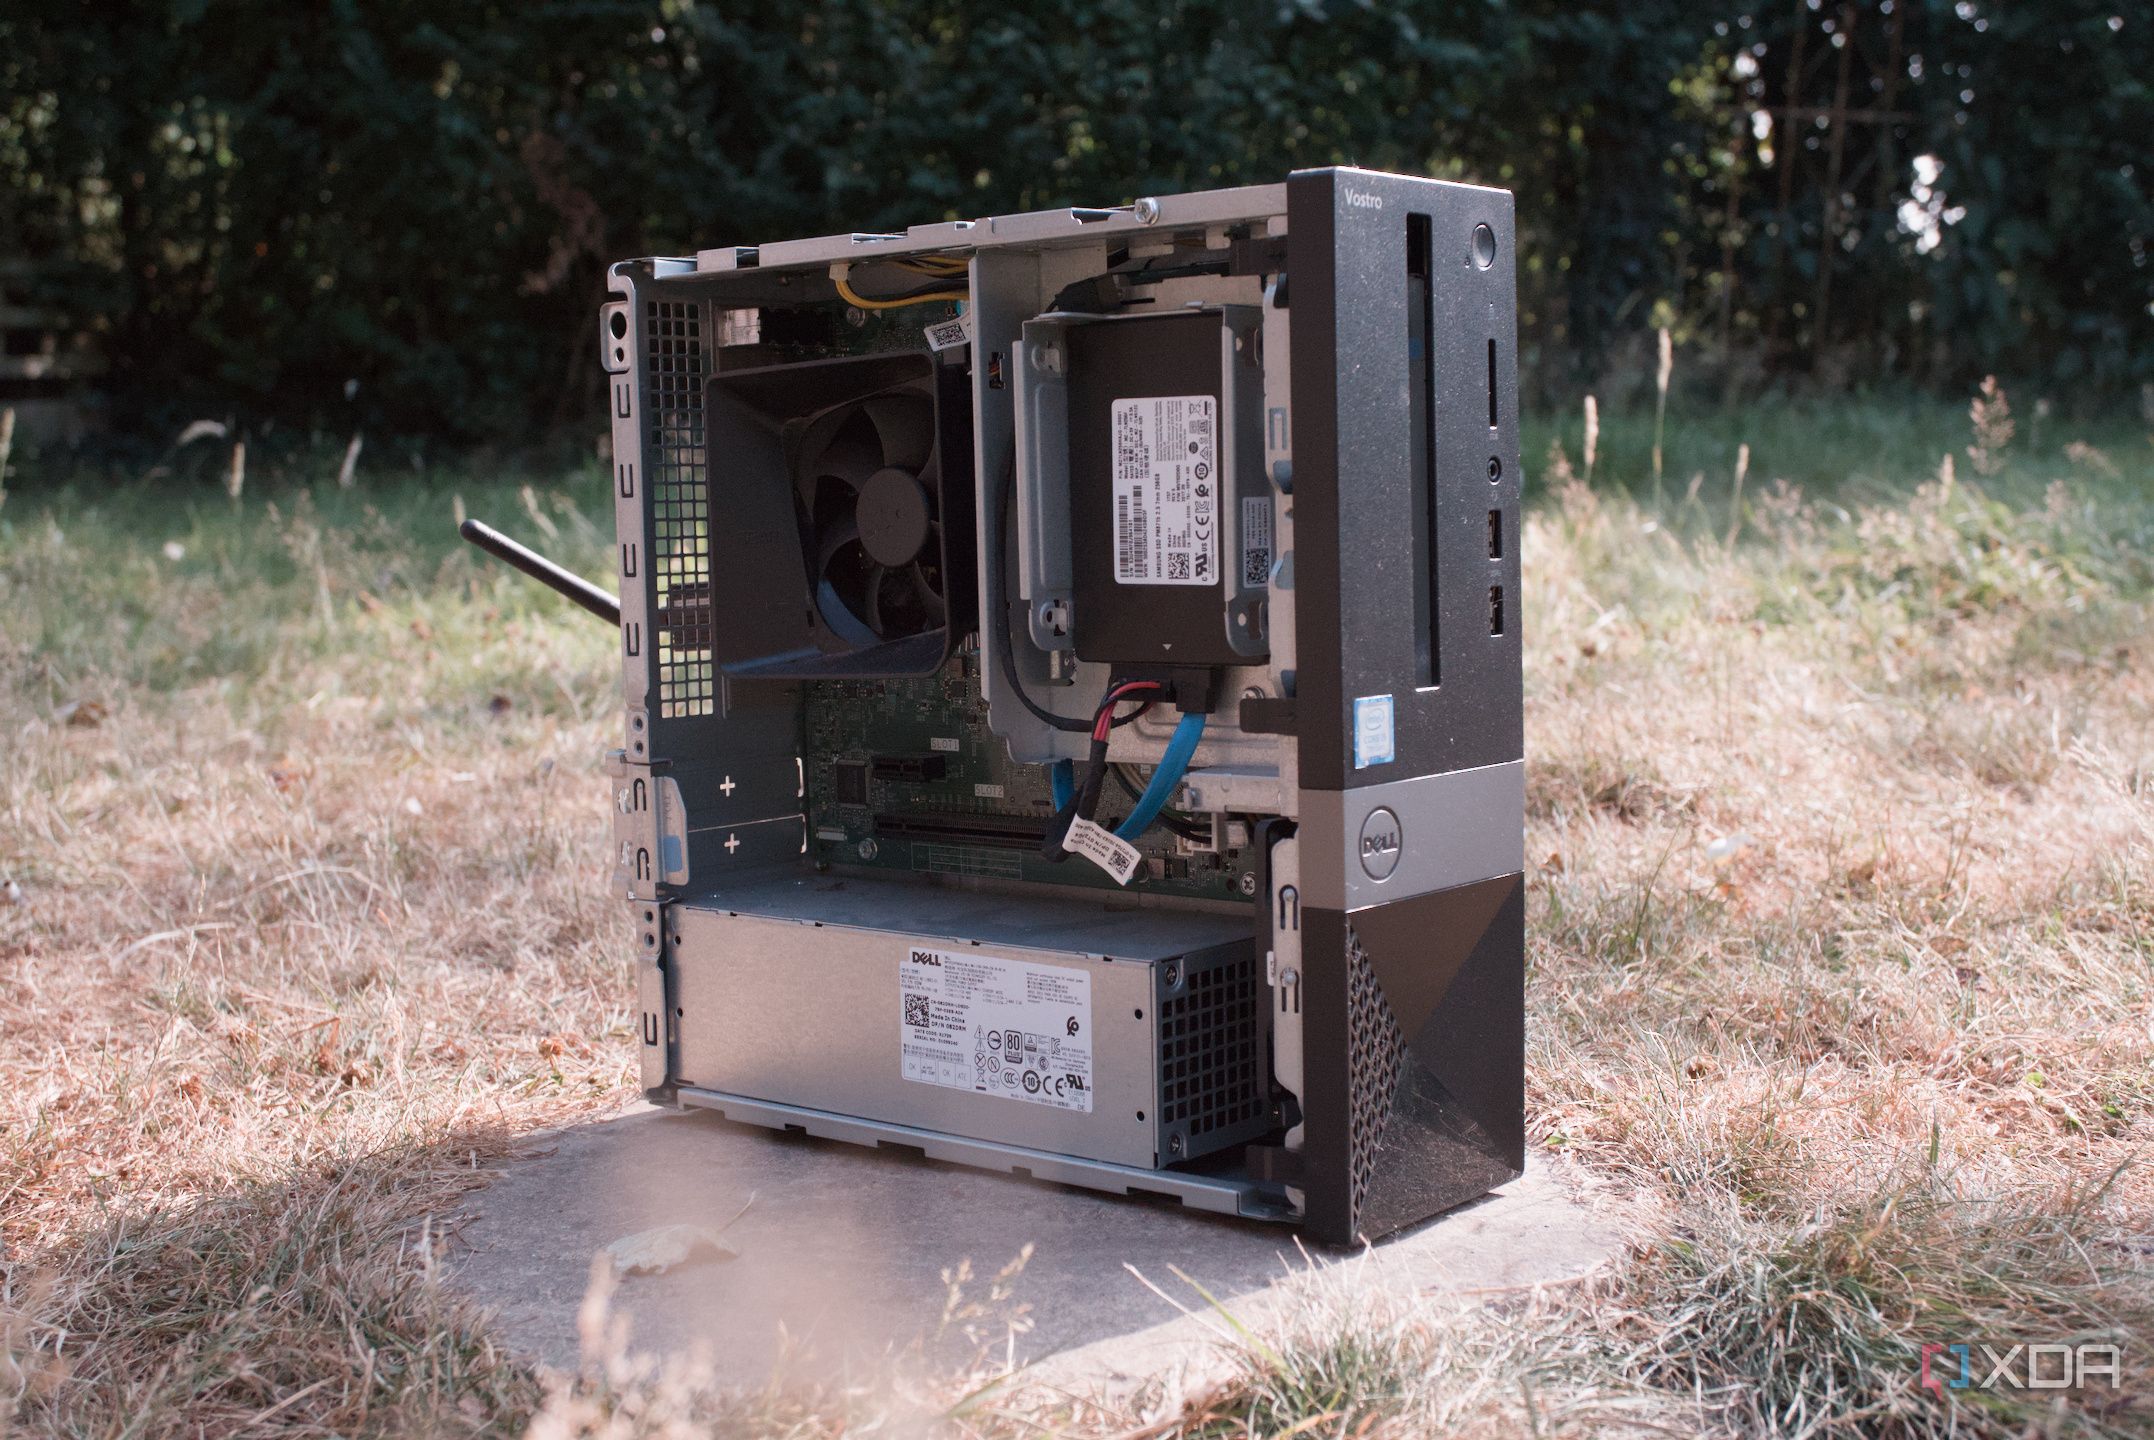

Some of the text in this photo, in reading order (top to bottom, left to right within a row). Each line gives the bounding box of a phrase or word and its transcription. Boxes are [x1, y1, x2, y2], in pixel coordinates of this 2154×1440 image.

[1345, 188, 1382, 210] Vostro
[931, 740, 959, 749] SLOT1
[976, 786, 1003, 794] SLOT2
[1363, 832, 1398, 855] DELL
[912, 951, 941, 967] DELL
[1007, 1034, 1020, 1050] 80
[1027, 1077, 1035, 1087] 10
